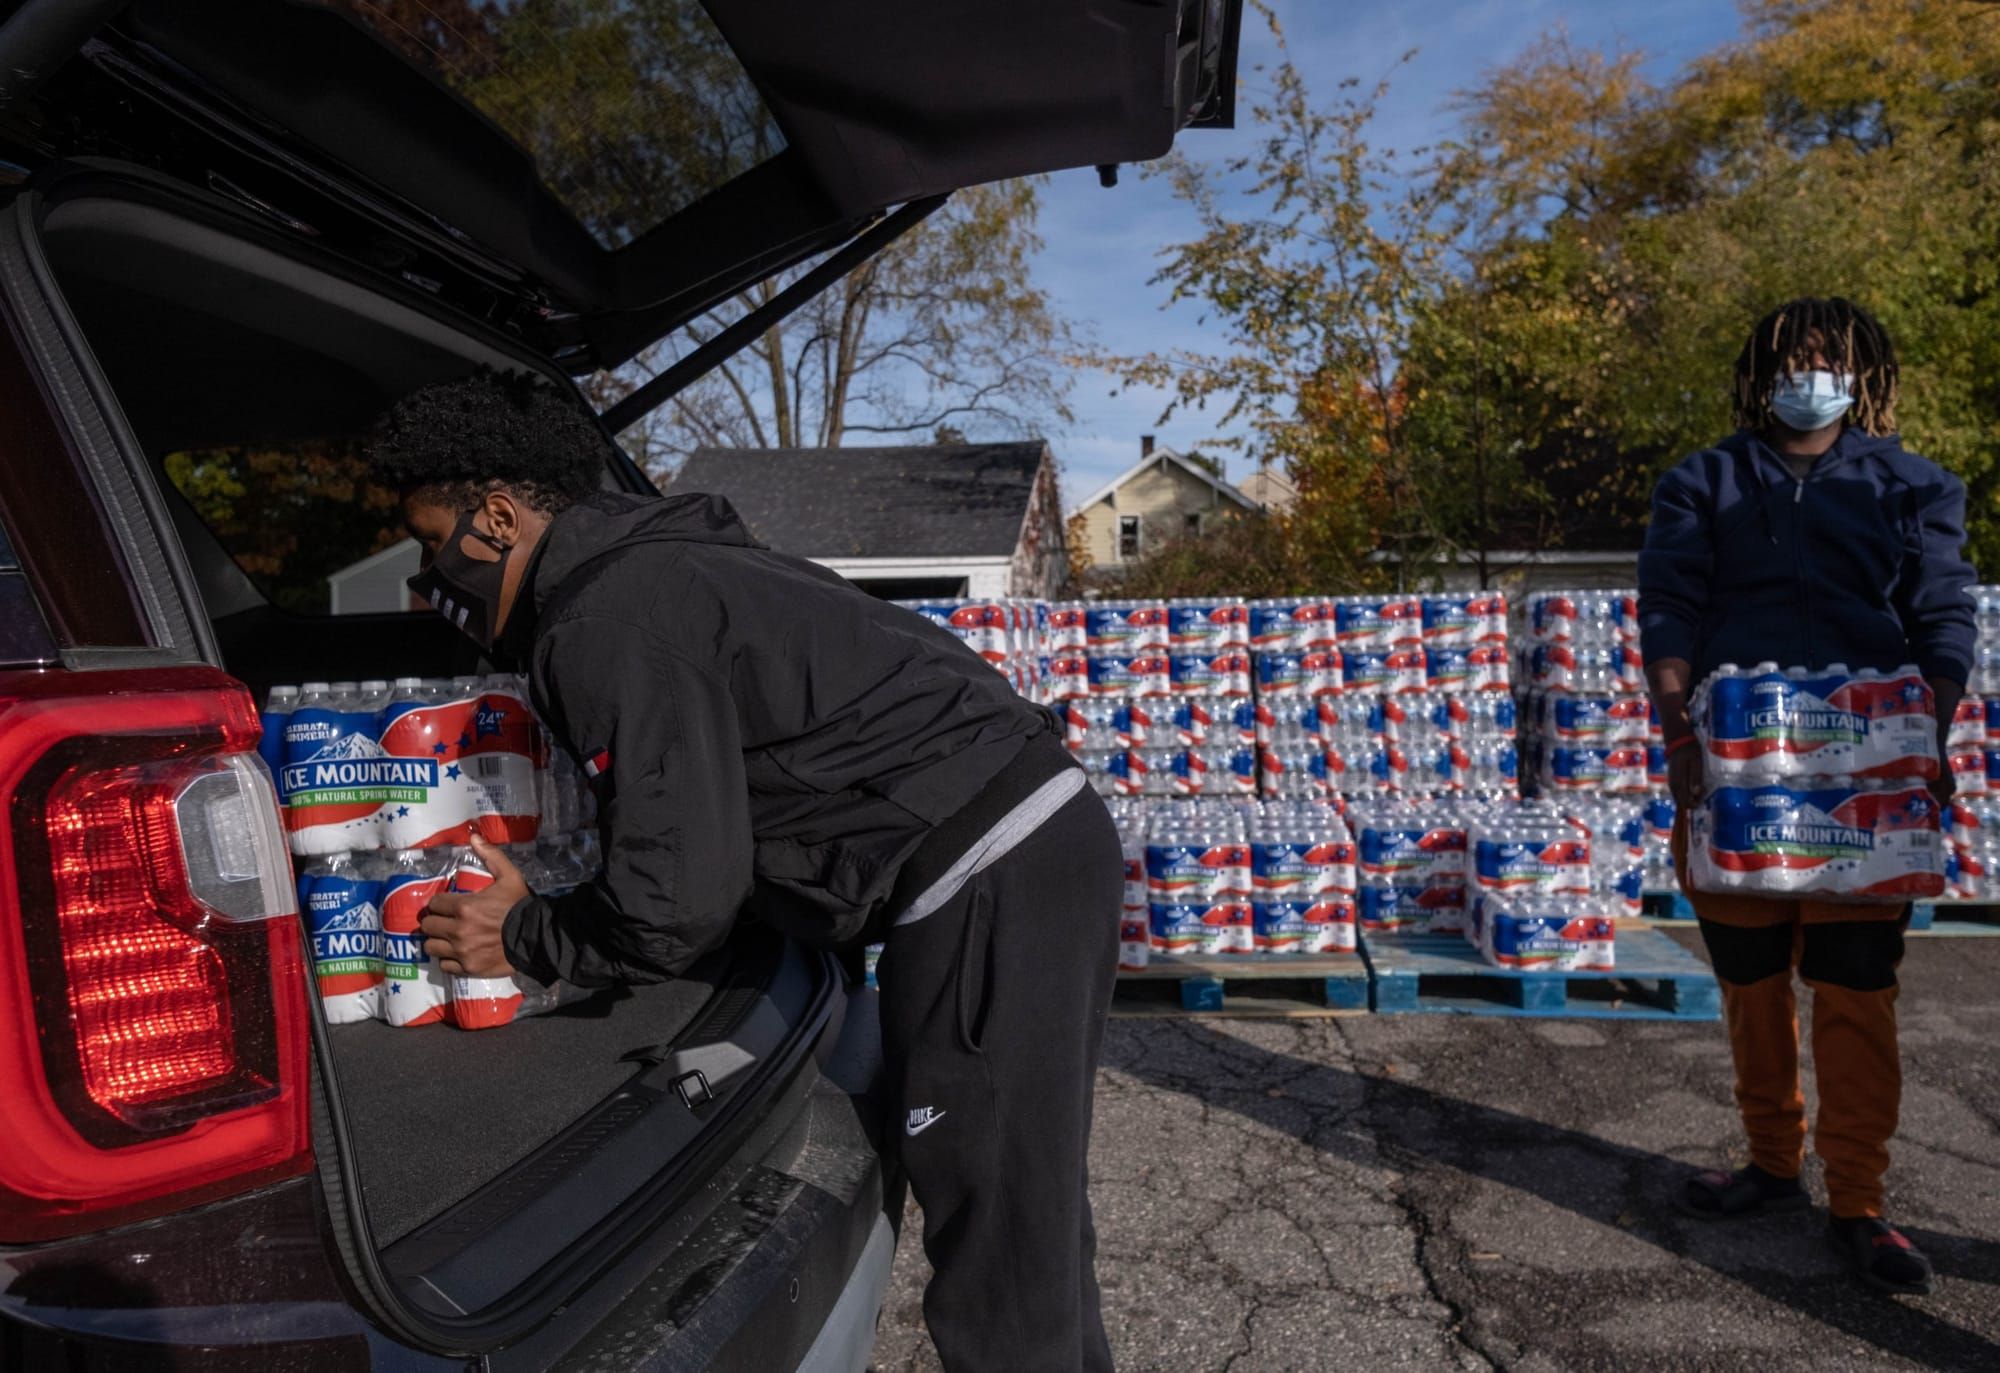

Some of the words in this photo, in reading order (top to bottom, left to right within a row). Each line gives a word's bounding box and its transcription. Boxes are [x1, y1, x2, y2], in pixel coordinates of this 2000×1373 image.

[478, 711, 495, 725] 24
[1751, 711, 1777, 728] ICE
[1781, 711, 1865, 732] MOUNTAIN
[284, 767, 310, 791] ICE
[316, 762, 431, 786] MOUNTAIN
[315, 791, 357, 803] NATURAL
[360, 789, 387, 801] SPRING
[389, 789, 421, 801] WATER
[1750, 825, 1777, 841] ICE
[1781, 825, 1871, 848] MOUNTAIN
[329, 961, 368, 973] NATURAL
[910, 1106, 934, 1125] NIKE
